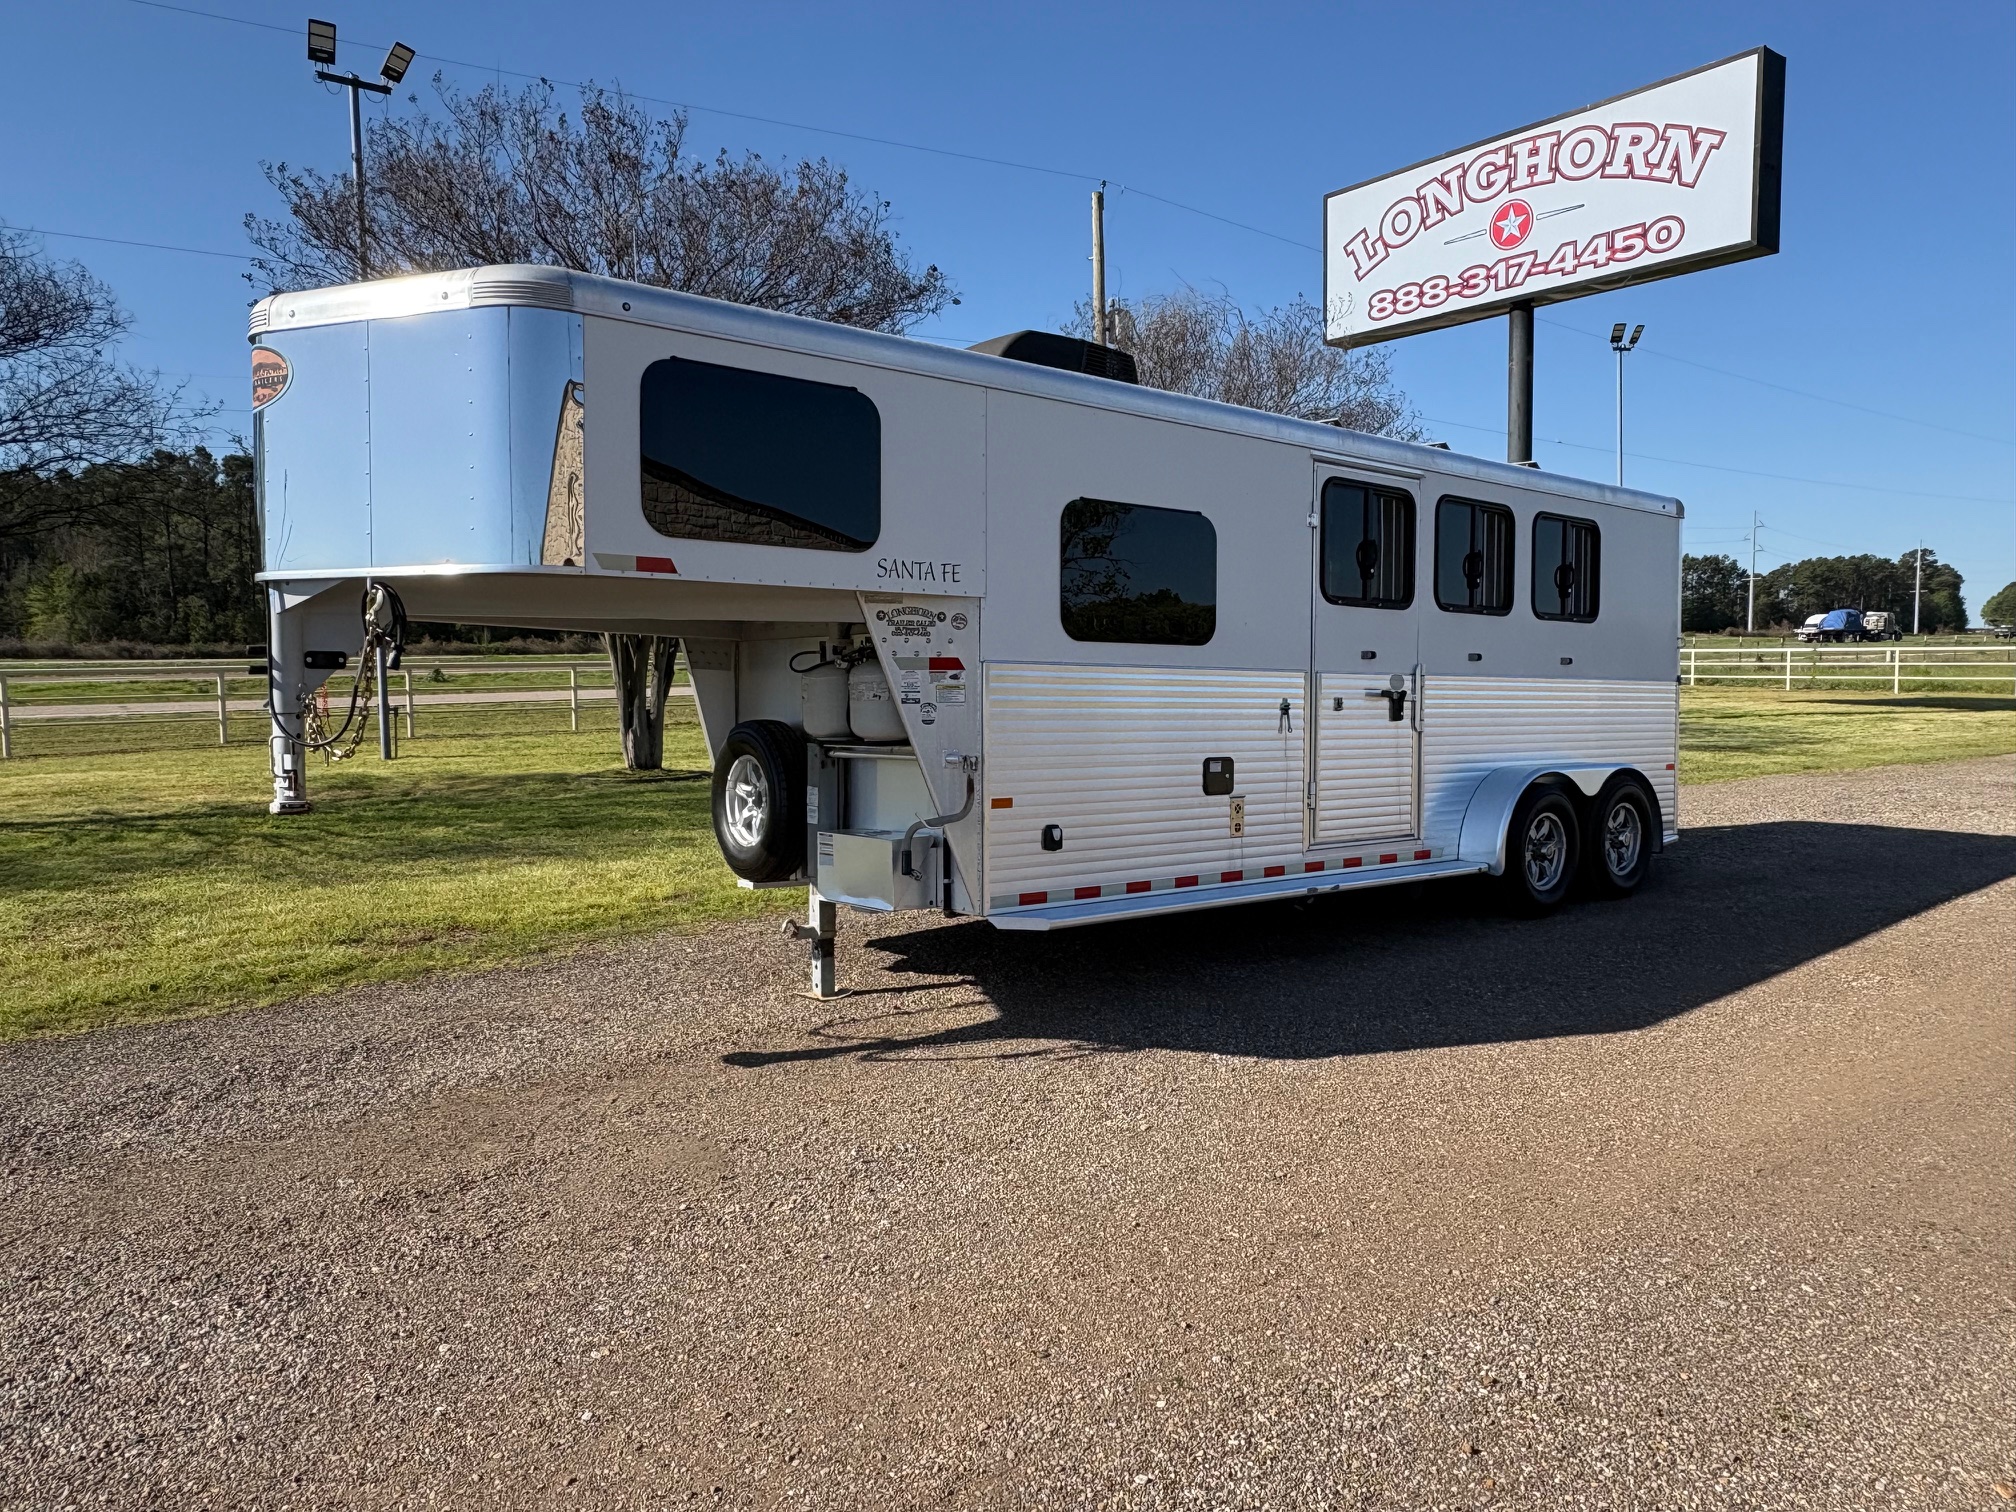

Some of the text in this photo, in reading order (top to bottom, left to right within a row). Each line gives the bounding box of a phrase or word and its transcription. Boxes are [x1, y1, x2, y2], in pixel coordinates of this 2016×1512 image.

[1343, 122, 1727, 281] LONGHORN
[1367, 215, 1686, 321] 888-317-4450
[877, 557, 961, 583] SANTA FE
